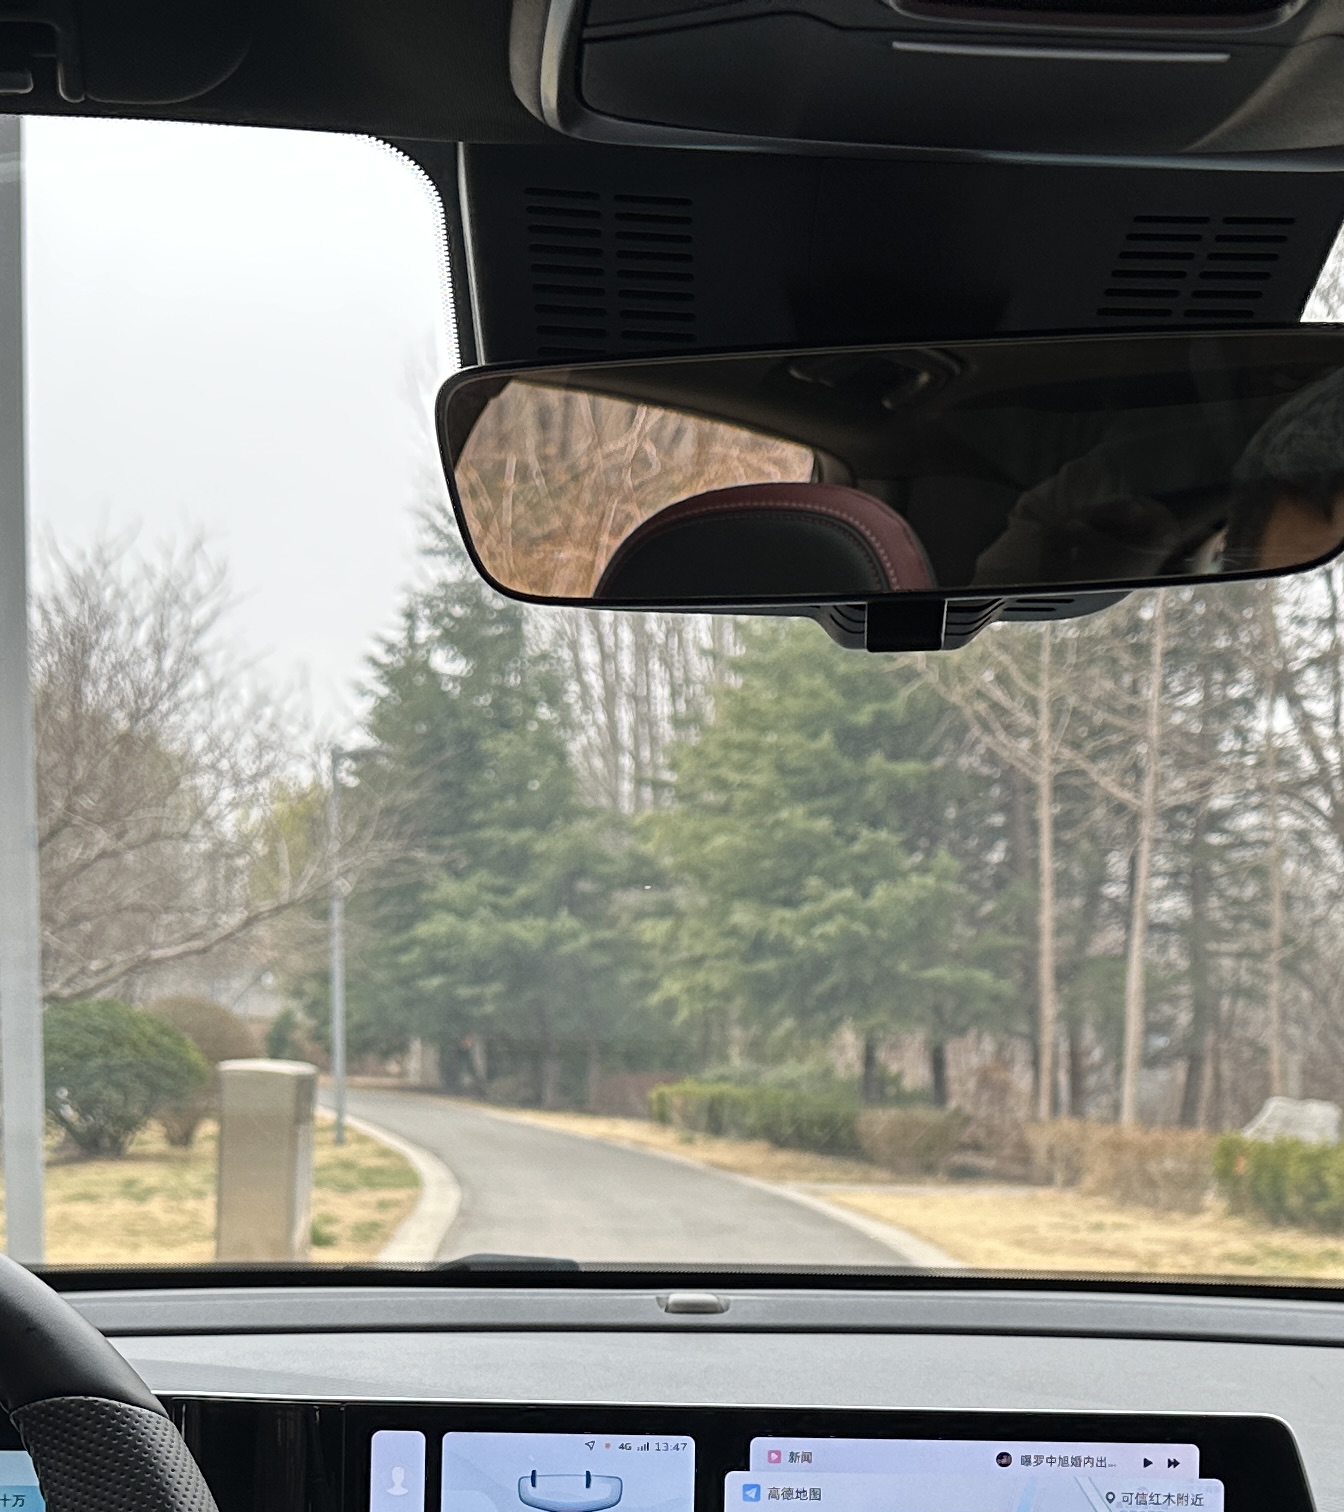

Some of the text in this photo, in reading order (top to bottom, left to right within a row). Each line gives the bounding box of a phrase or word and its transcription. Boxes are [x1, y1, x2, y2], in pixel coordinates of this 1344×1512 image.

[618, 1442, 632, 1451] 4G
[655, 1442, 688, 1452] 13:47
[788, 1451, 813, 1464] 新闻
[767, 1487, 822, 1501] 高德地图
[1121, 1492, 1205, 1507] 可信红木附近
